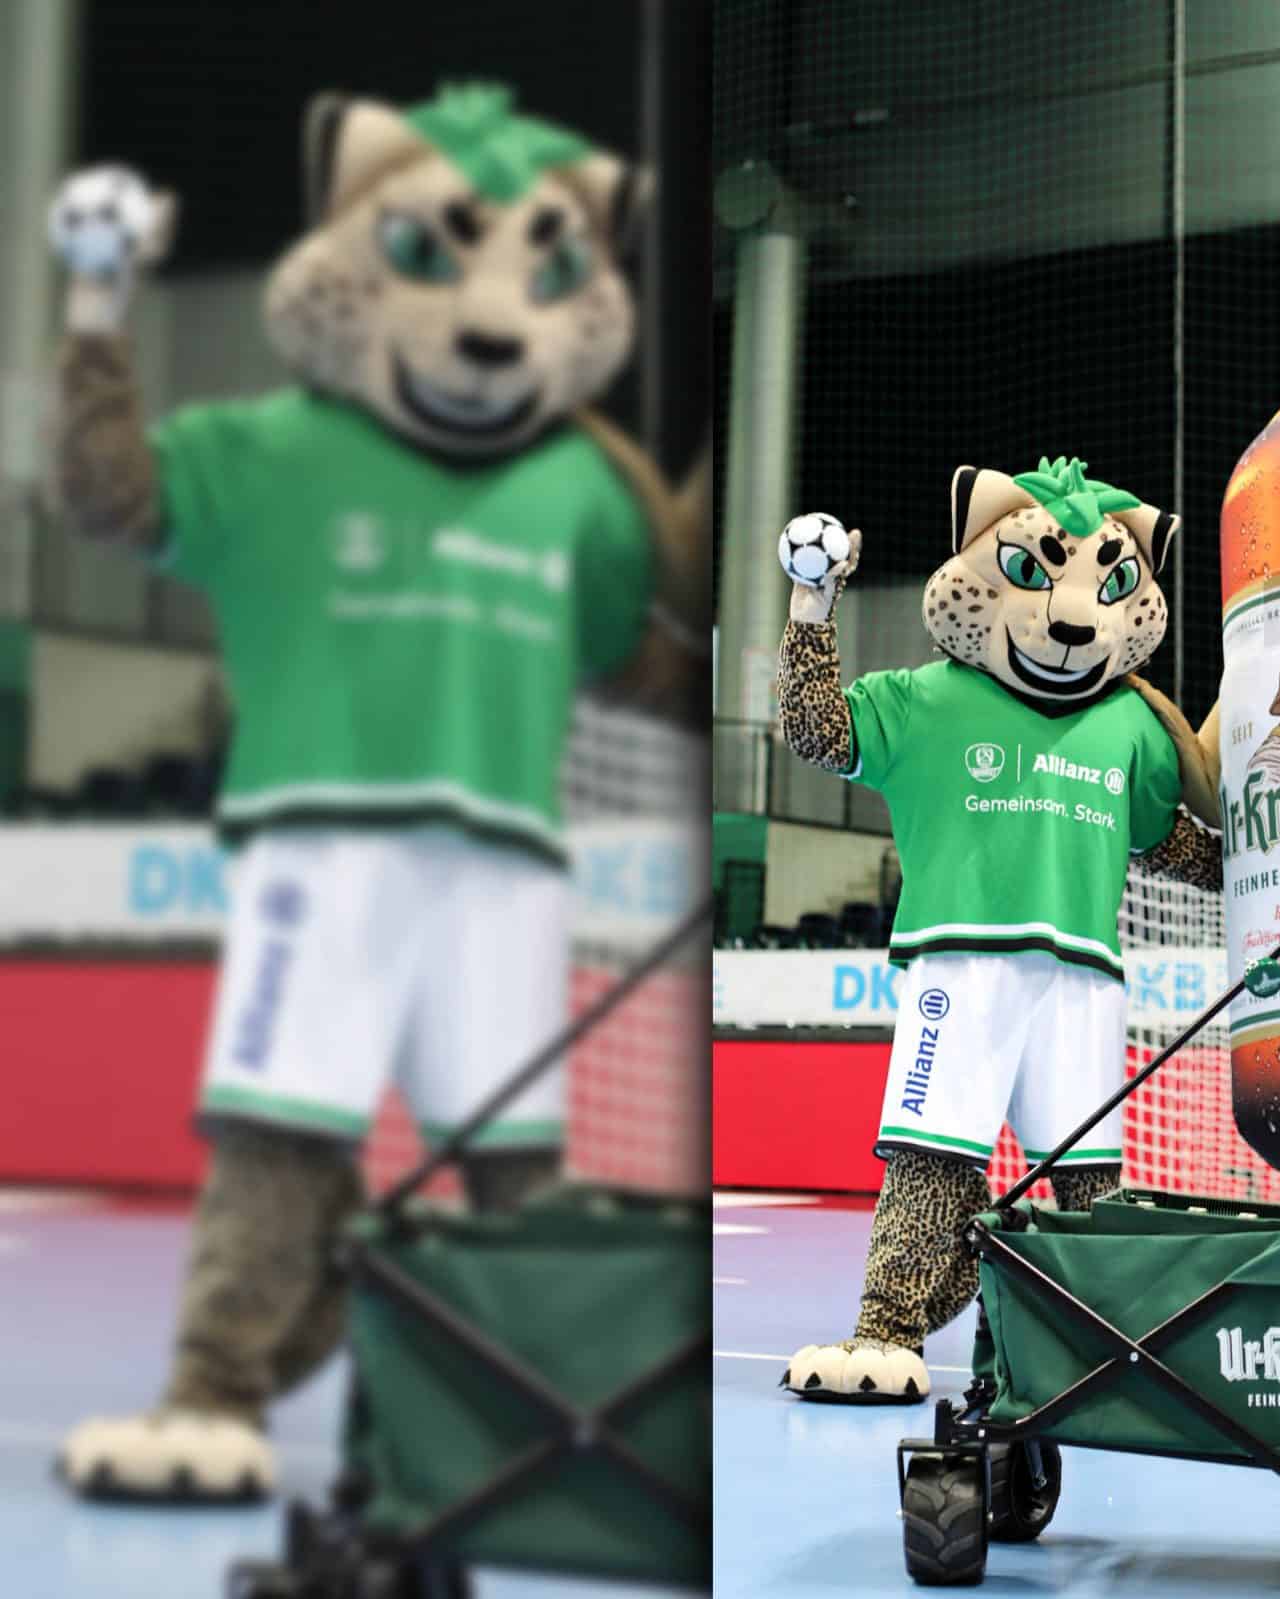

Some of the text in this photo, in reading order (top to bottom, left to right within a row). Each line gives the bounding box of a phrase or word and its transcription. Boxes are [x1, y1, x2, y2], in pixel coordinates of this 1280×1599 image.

[1032, 753, 1102, 784] Allianz
[965, 794, 1069, 817] Gemeinsam.
[832, 963, 899, 1010] DK
[1134, 962, 1207, 1011] KB
[901, 1026, 939, 1117] Allianz
